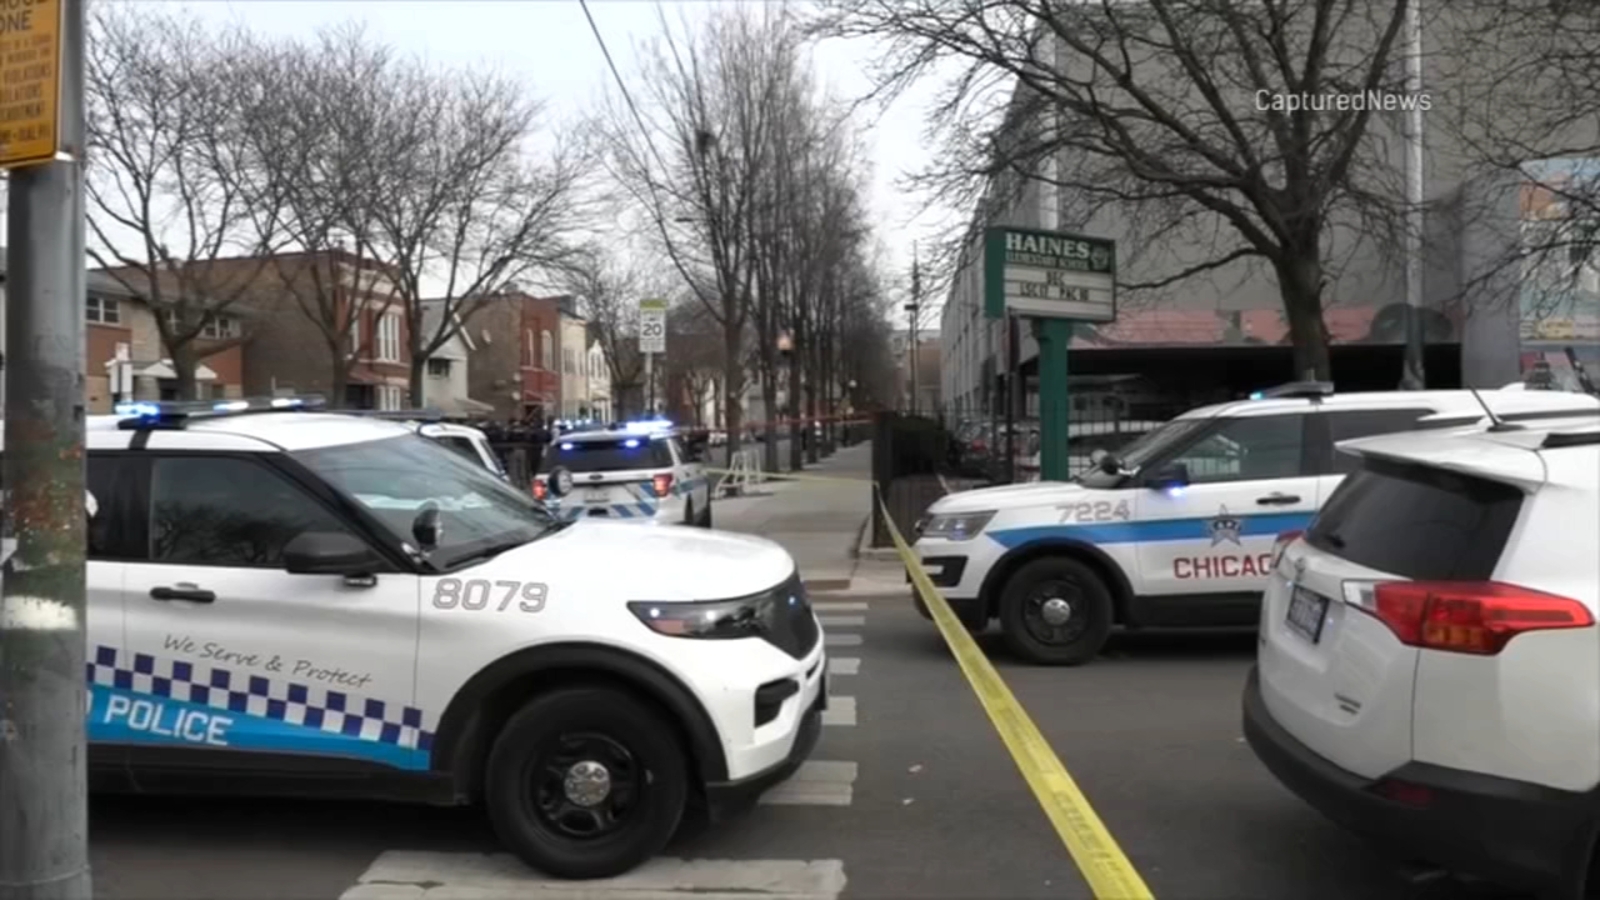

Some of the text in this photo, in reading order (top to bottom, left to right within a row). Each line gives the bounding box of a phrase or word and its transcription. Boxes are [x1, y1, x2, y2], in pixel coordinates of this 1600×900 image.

[1005, 232, 1090, 259] HAINES
[643, 323, 662, 336] 20
[1055, 500, 1131, 523] 7224
[432, 578, 549, 612] 8079
[163, 634, 373, 688] We Serve & Protect
[103, 694, 234, 746] POLICE
